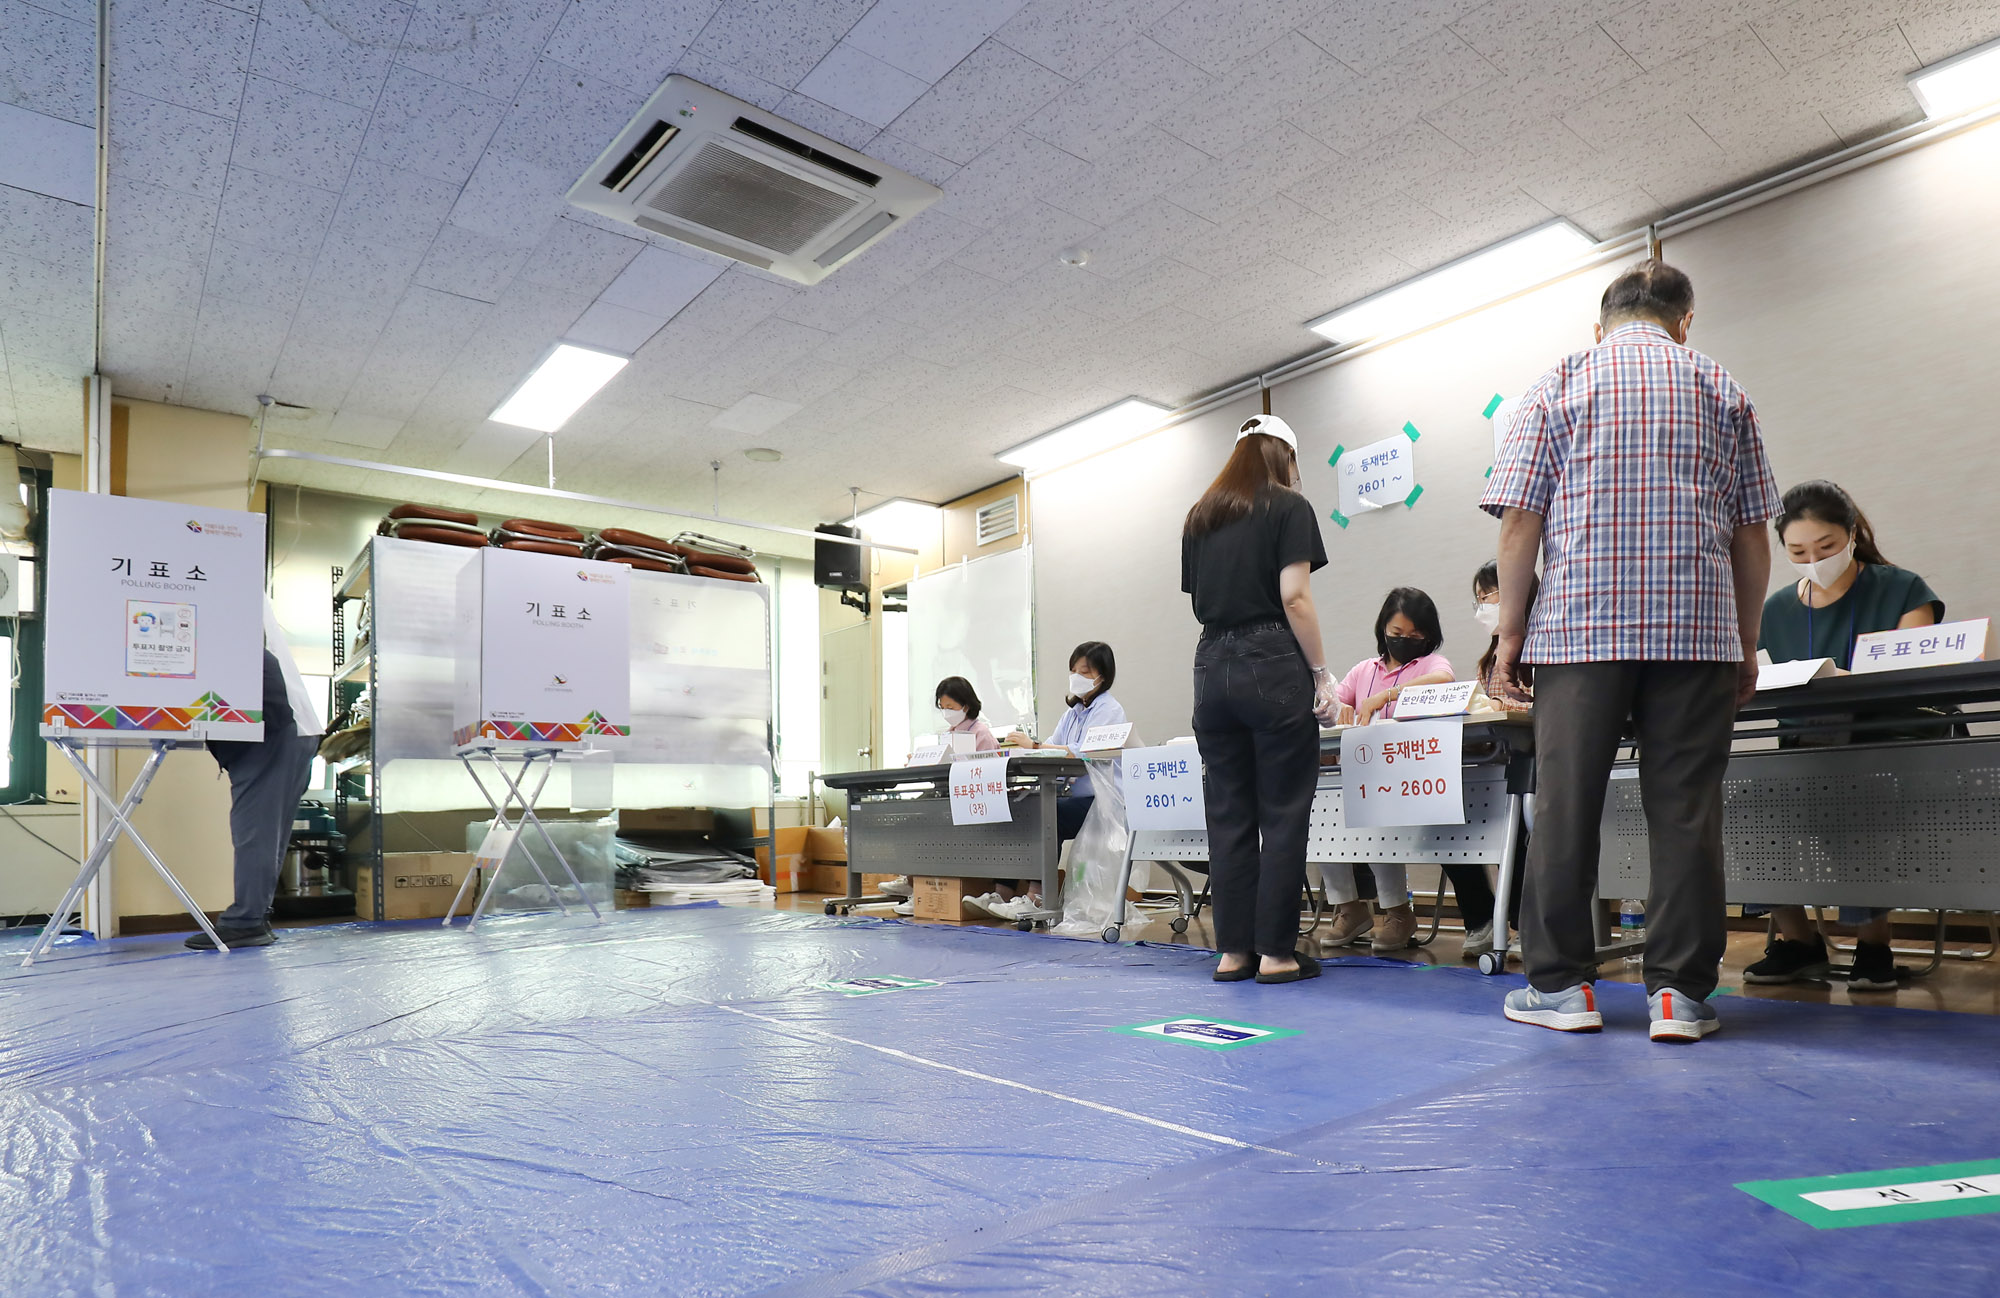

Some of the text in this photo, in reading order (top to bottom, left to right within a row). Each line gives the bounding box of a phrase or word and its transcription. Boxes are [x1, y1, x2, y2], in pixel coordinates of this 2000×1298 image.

[1360, 448, 1400, 472] 등재번호
[1358, 478, 1386, 495] 2601
[121, 579, 196, 592] POLLING BOOTH
[532, 619, 560, 628] POLLING
[133, 643, 156, 651] 투표지
[1401, 691, 1469, 706] 본인확인 하는 곳
[1382, 737, 1442, 764] 등재번호
[970, 767, 982, 779] 1차
[1147, 760, 1189, 780] 등재번호
[953, 781, 1004, 800] 투표용지 배부
[1360, 784, 1366, 799] 1
[1401, 778, 1447, 796] 2600
[1145, 794, 1176, 808] 2601
[969, 802, 988, 816] (3장)
